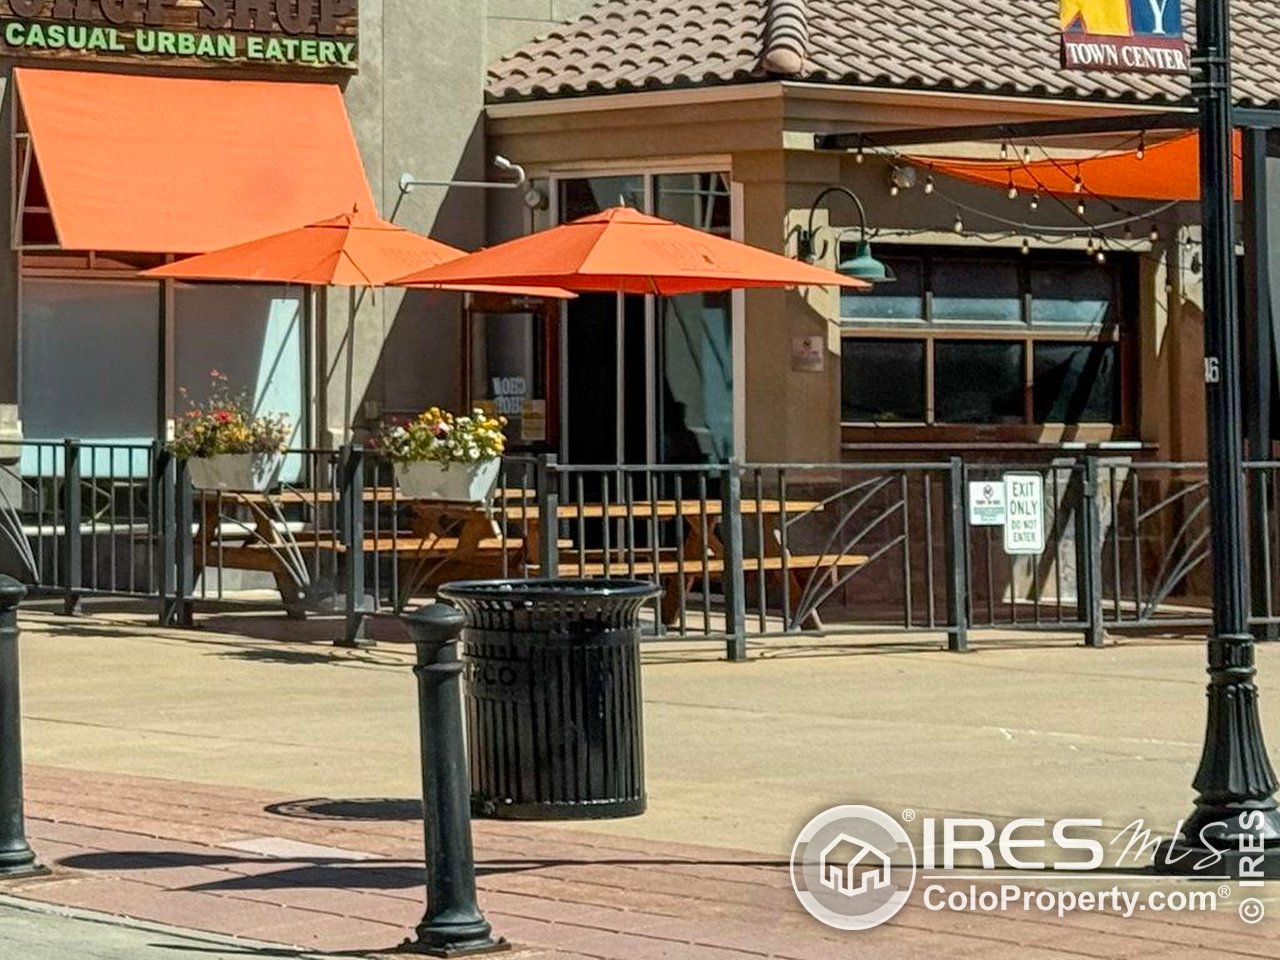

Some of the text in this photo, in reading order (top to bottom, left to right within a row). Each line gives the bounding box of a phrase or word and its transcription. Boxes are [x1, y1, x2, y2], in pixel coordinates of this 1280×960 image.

[6, 22, 355, 65] CASUAL URBAN EATERY
[1067, 43, 1187, 71] TOWN CENTER
[1013, 482, 1034, 497] EXIT
[1010, 501, 1037, 515] ONLY
[1012, 520, 1036, 530] DO NOT
[1013, 532, 1035, 542] ENTER
